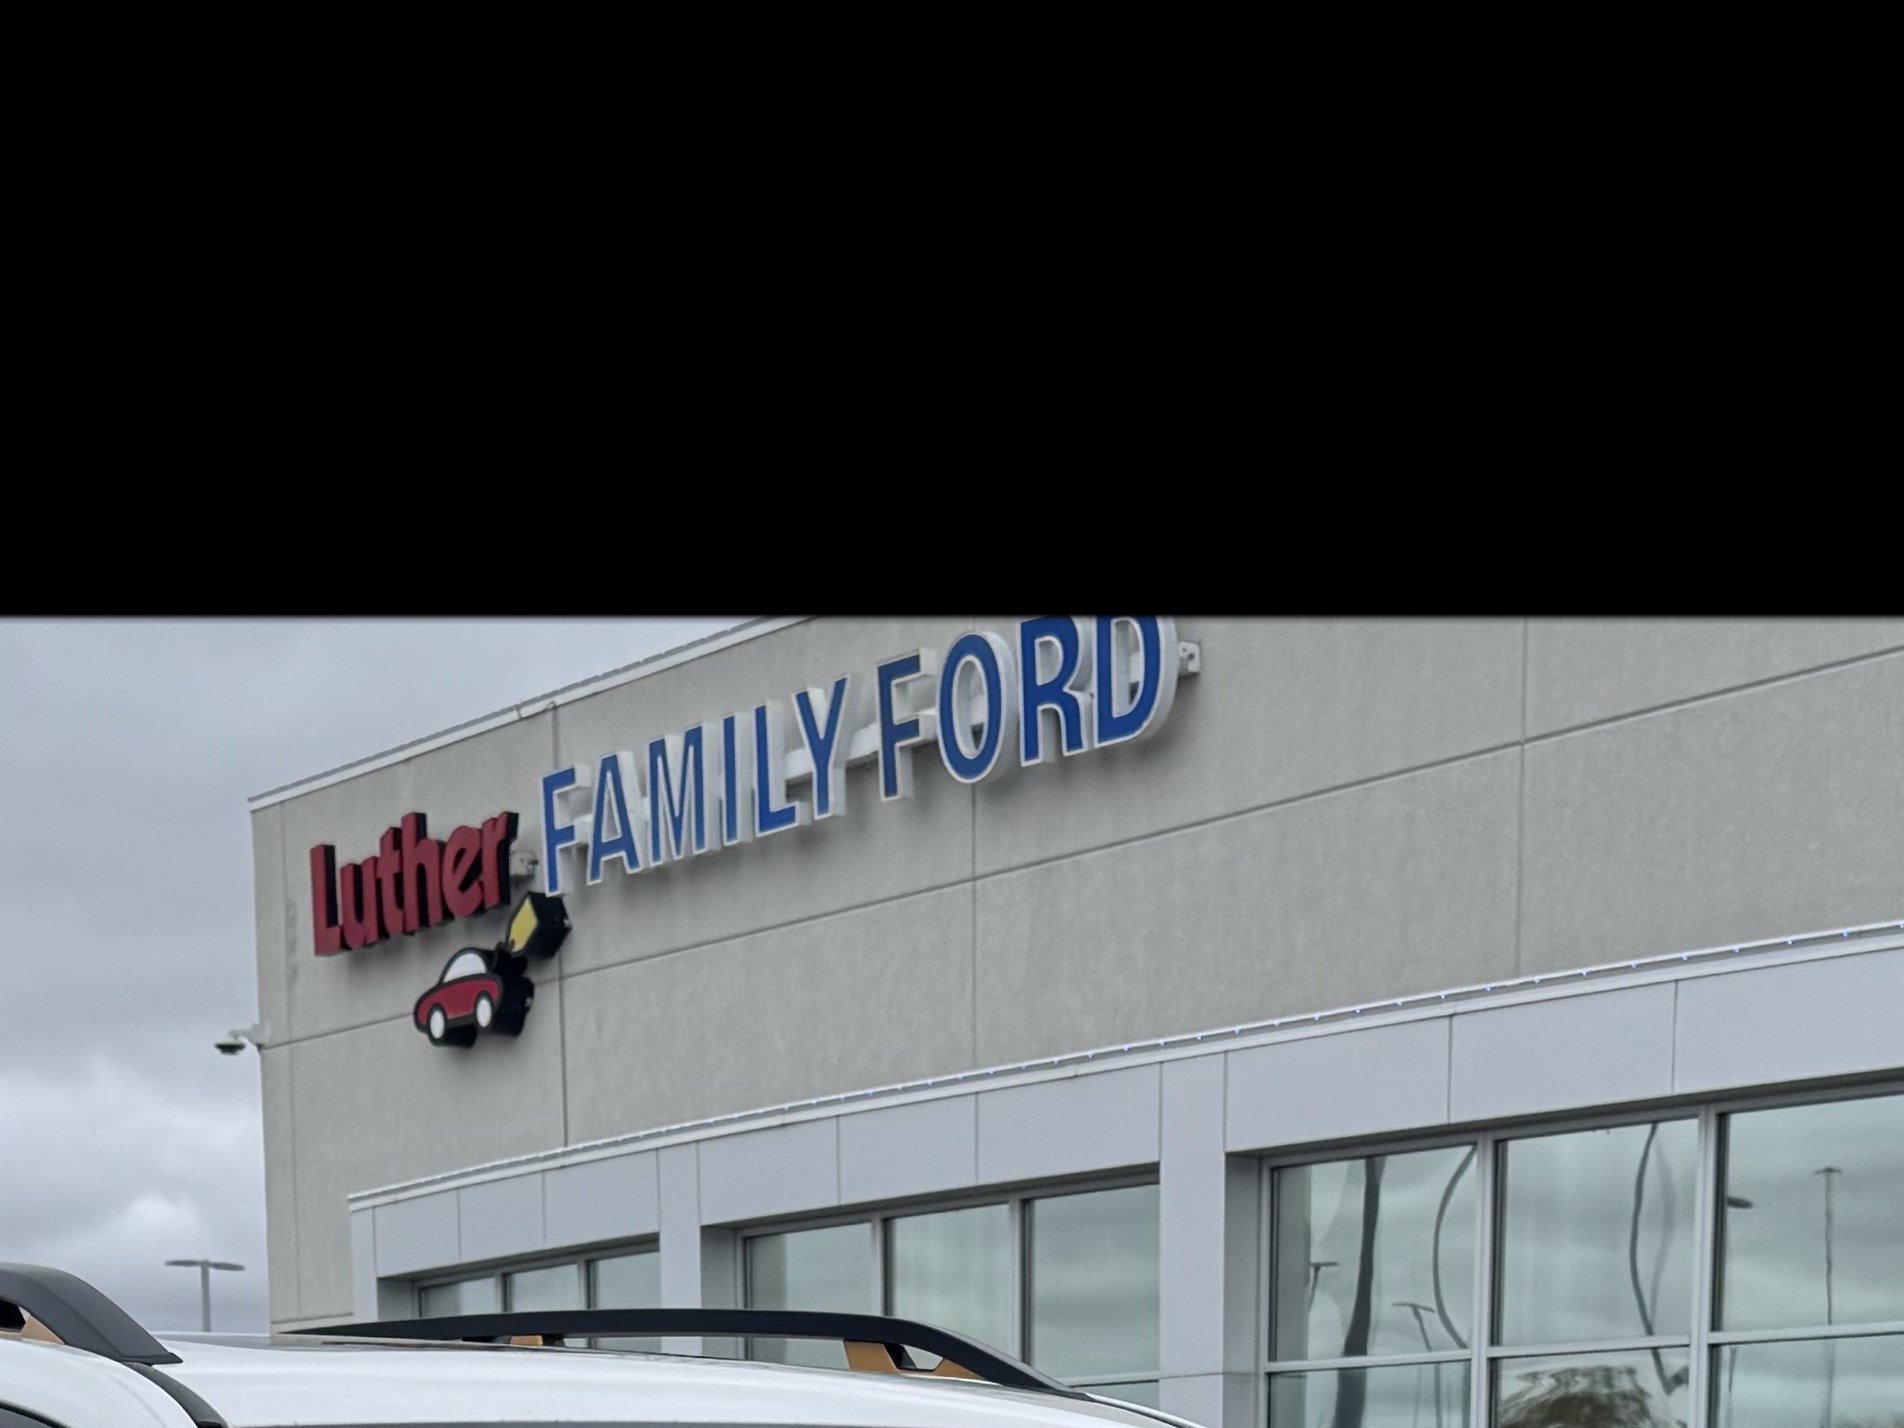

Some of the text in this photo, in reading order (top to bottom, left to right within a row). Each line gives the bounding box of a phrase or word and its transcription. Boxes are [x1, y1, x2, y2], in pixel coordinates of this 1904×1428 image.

[541, 615, 1168, 898] FAMILY FORD
[310, 811, 520, 957] Luther
